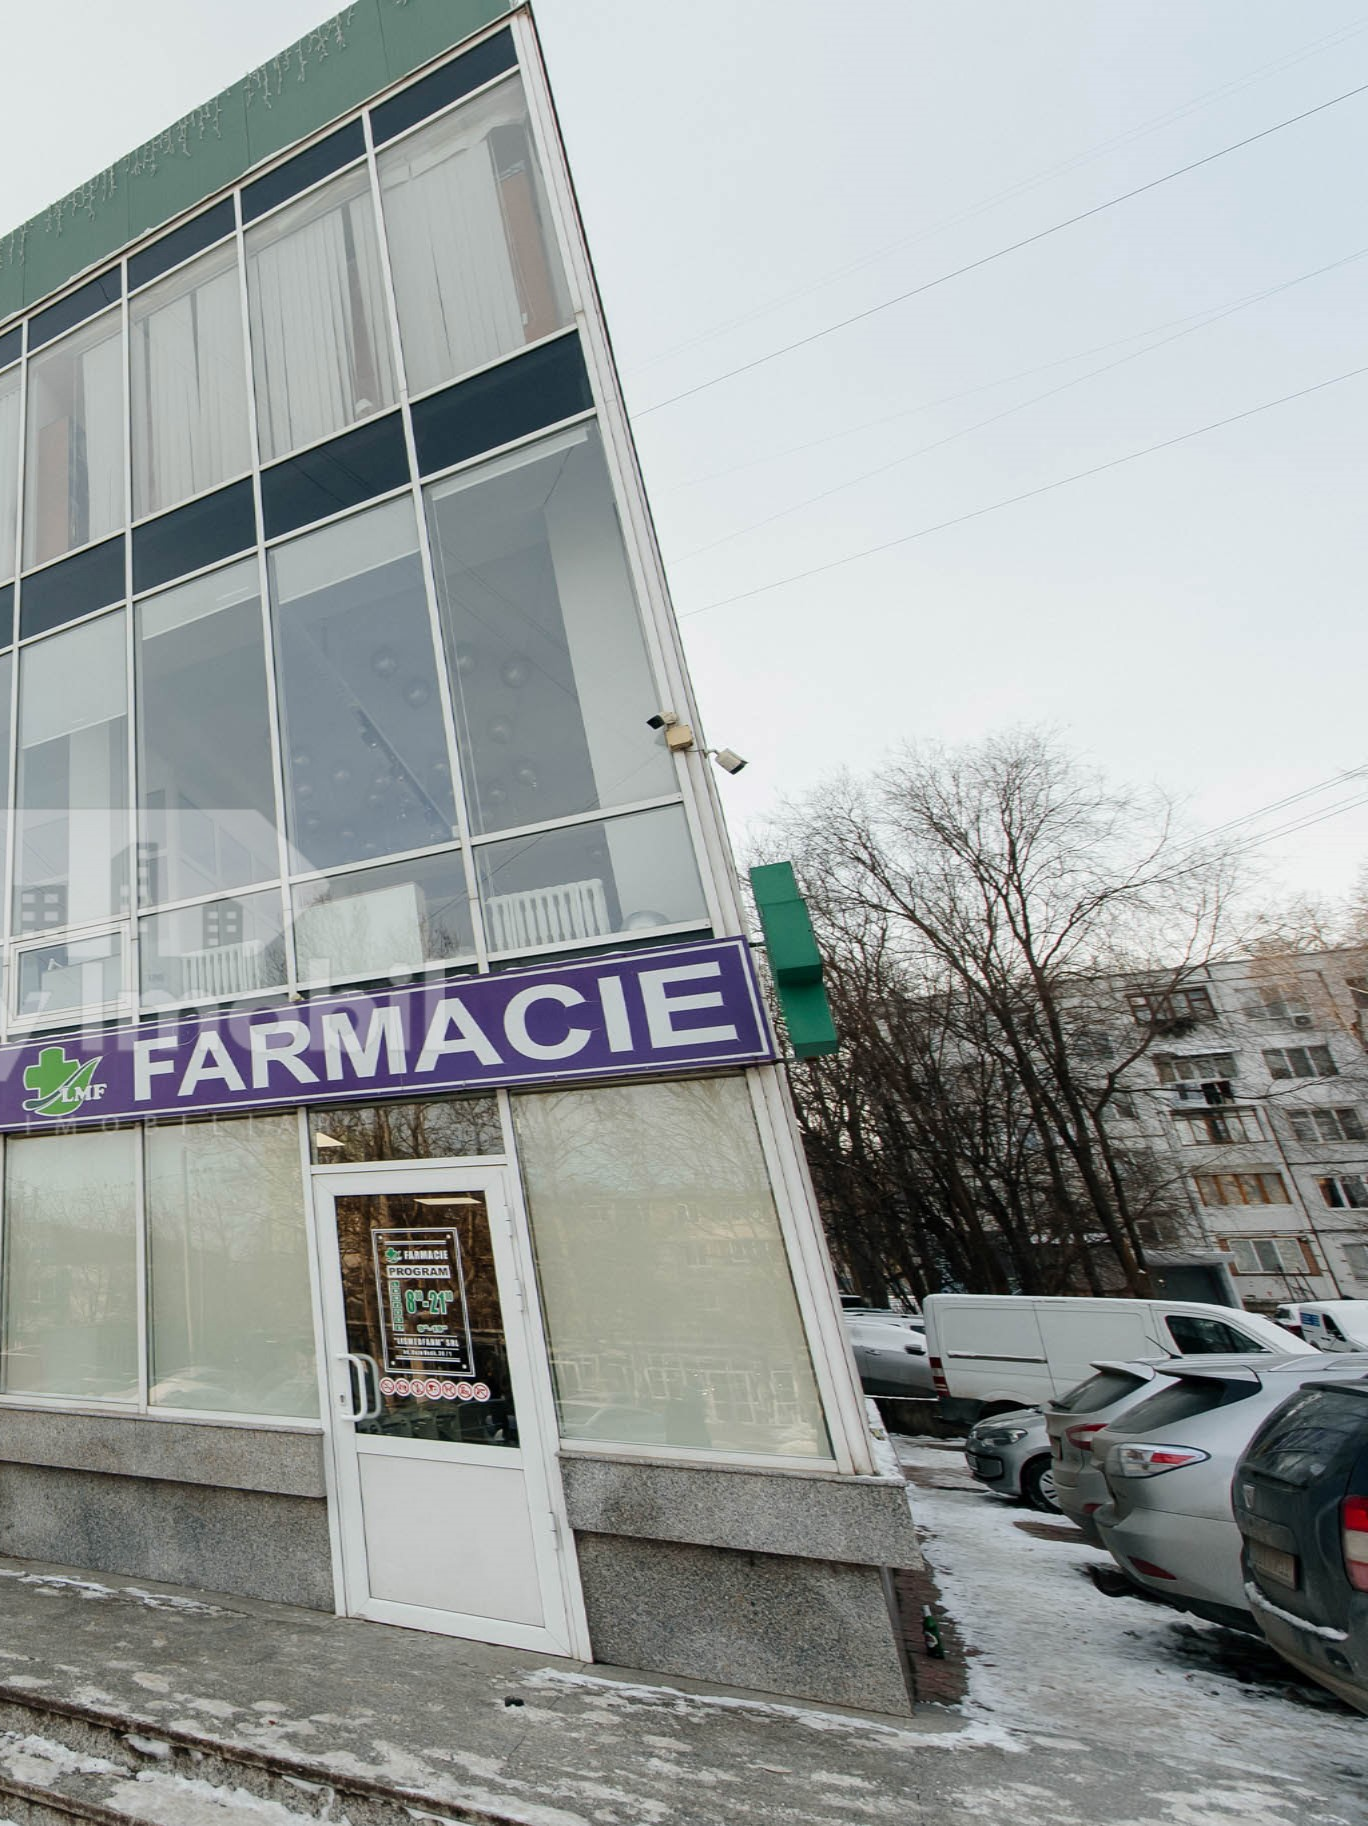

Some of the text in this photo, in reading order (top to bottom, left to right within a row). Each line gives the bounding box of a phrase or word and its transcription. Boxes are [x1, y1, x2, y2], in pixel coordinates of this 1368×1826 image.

[133, 961, 740, 1102] FARMACIE
[60, 1082, 109, 1103] LMF
[403, 1250, 449, 1260] FARMACIE
[389, 1267, 449, 1277] PROGRAM
